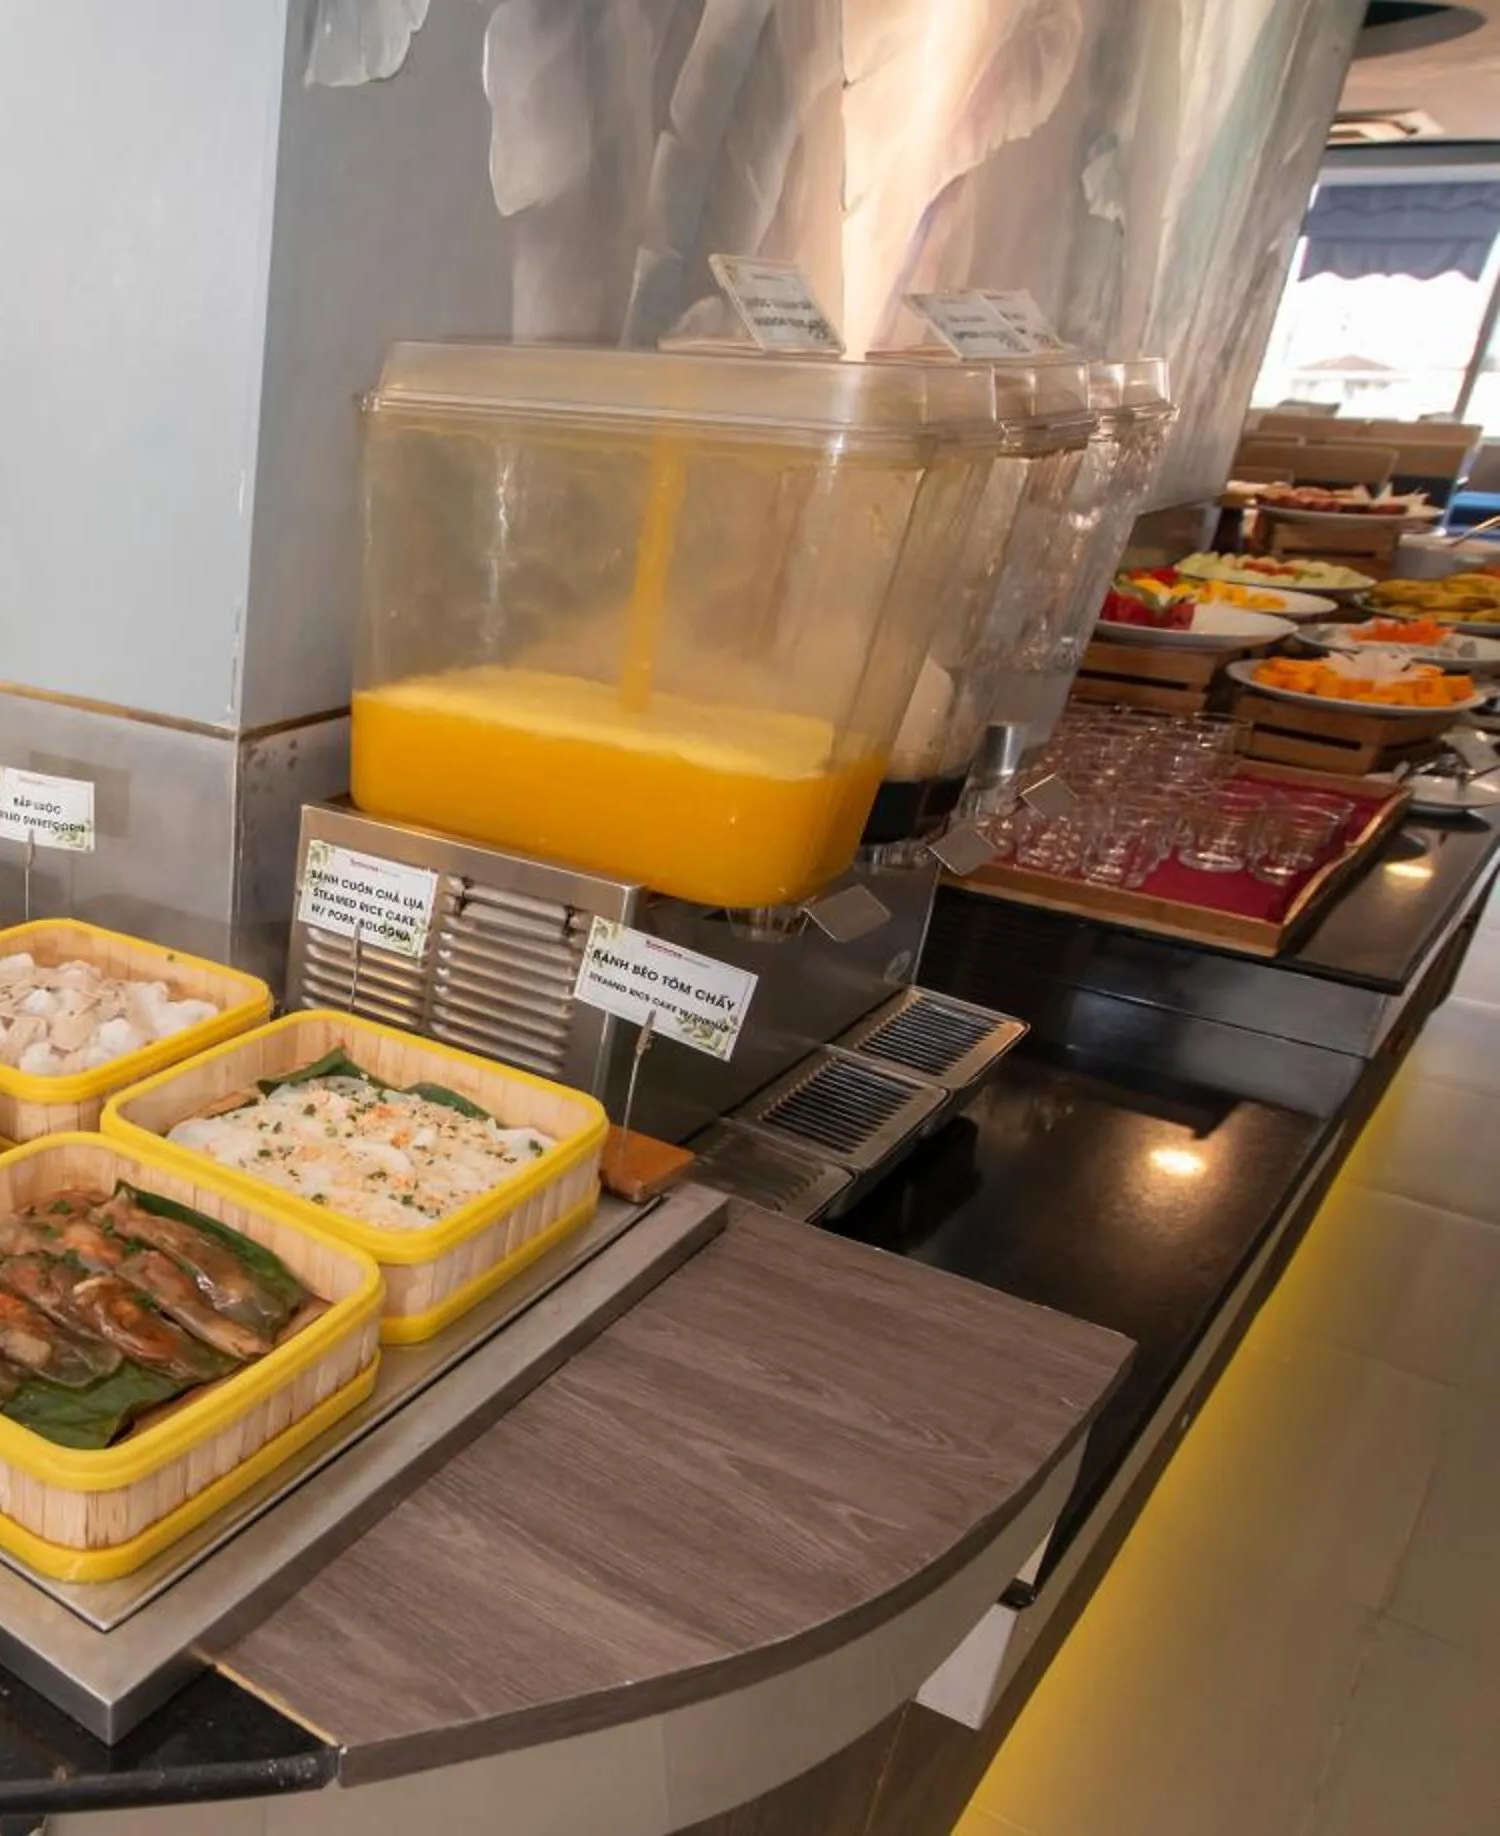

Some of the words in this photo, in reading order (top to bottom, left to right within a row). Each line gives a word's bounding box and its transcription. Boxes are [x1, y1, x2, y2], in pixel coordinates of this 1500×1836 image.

[313, 887, 357, 909] STEAMED
[359, 901, 385, 917] RICE
[385, 909, 416, 926] CAKE
[327, 909, 356, 926] PORK
[358, 917, 412, 942] BOLOGNA
[592, 949, 629, 972] BÁNH
[631, 962, 659, 982] BÈO
[662, 974, 693, 995] TÔM
[651, 997, 678, 1014] CAKE
